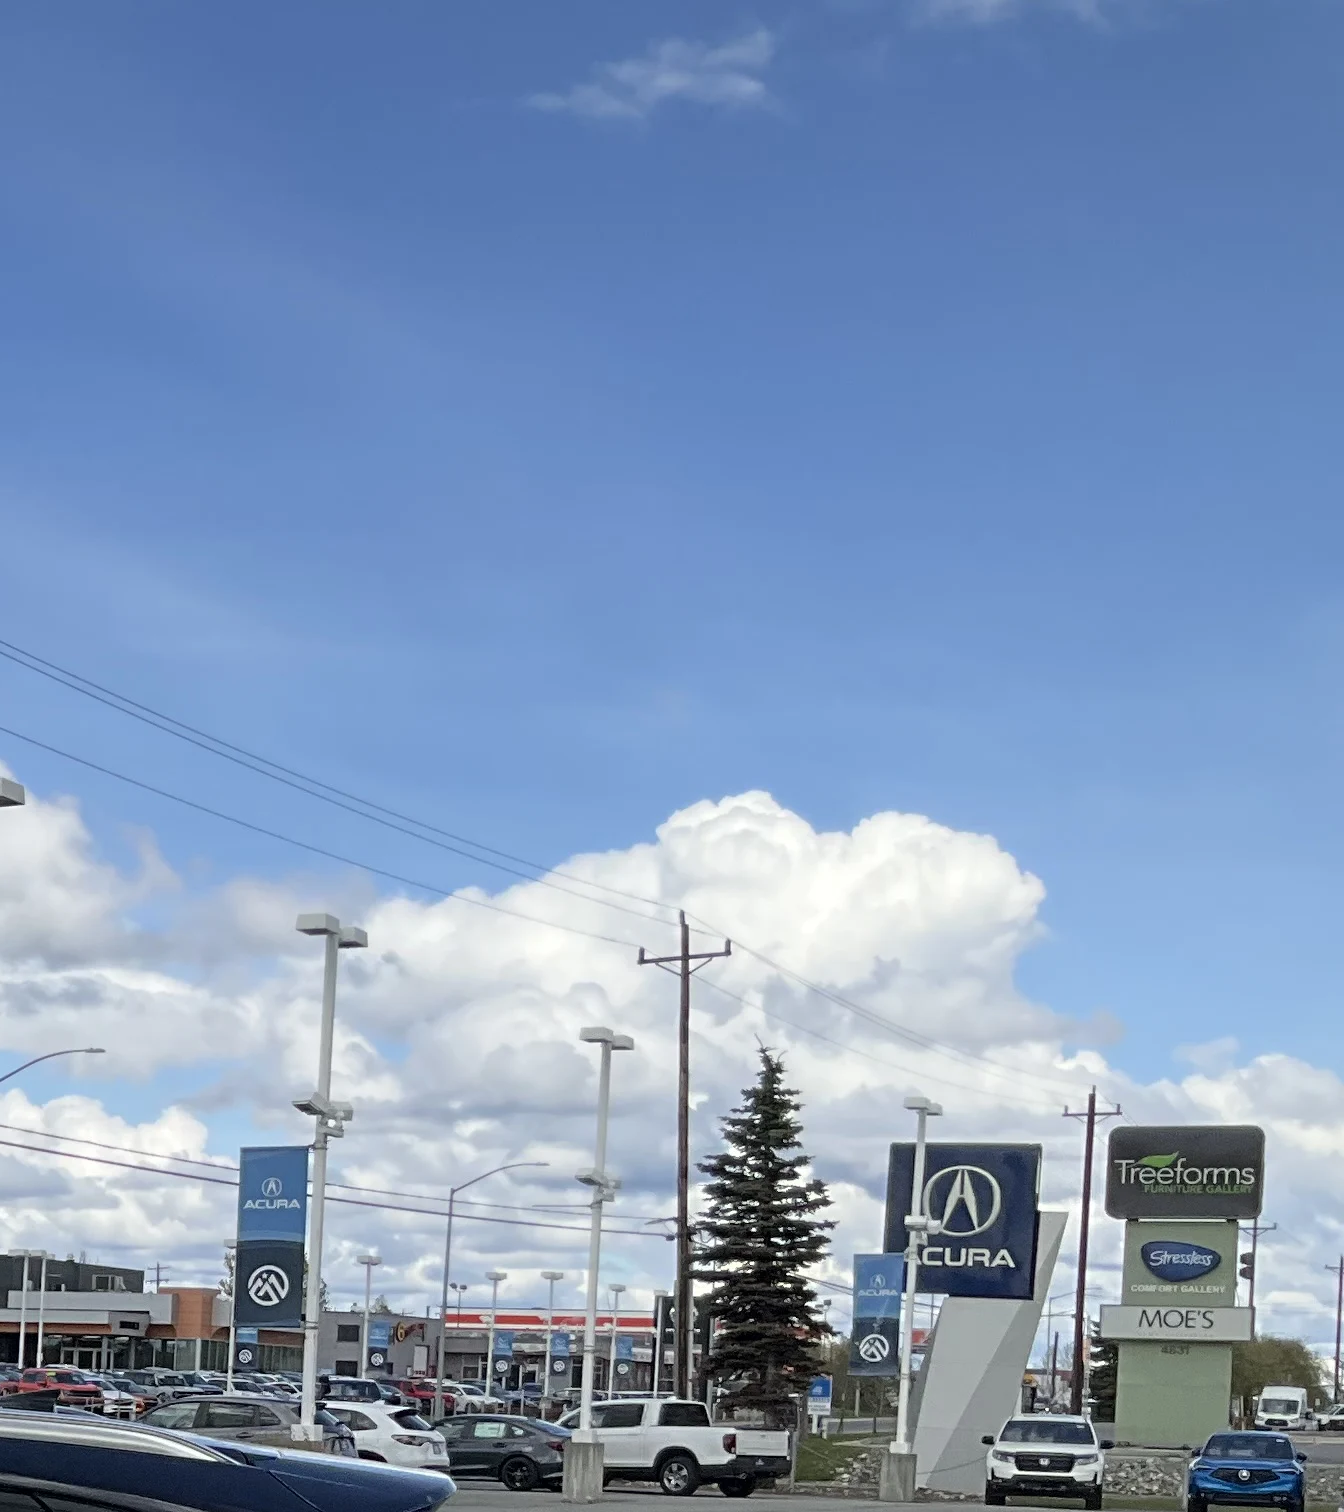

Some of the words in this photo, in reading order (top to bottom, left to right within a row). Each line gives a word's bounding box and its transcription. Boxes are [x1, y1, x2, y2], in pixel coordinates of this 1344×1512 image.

[1114, 1157, 1256, 1185] Treeforms
[1144, 1184, 1204, 1194] FURNITURE
[1205, 1184, 1254, 1194] GALLERY
[243, 1199, 301, 1210] ACURA
[1150, 1250, 1214, 1267] Stressless
[857, 1289, 898, 1297] ACURA
[1130, 1284, 1178, 1293] COMFORT
[1180, 1284, 1227, 1294] GALLERY
[1138, 1309, 1214, 1329] MOE'S
